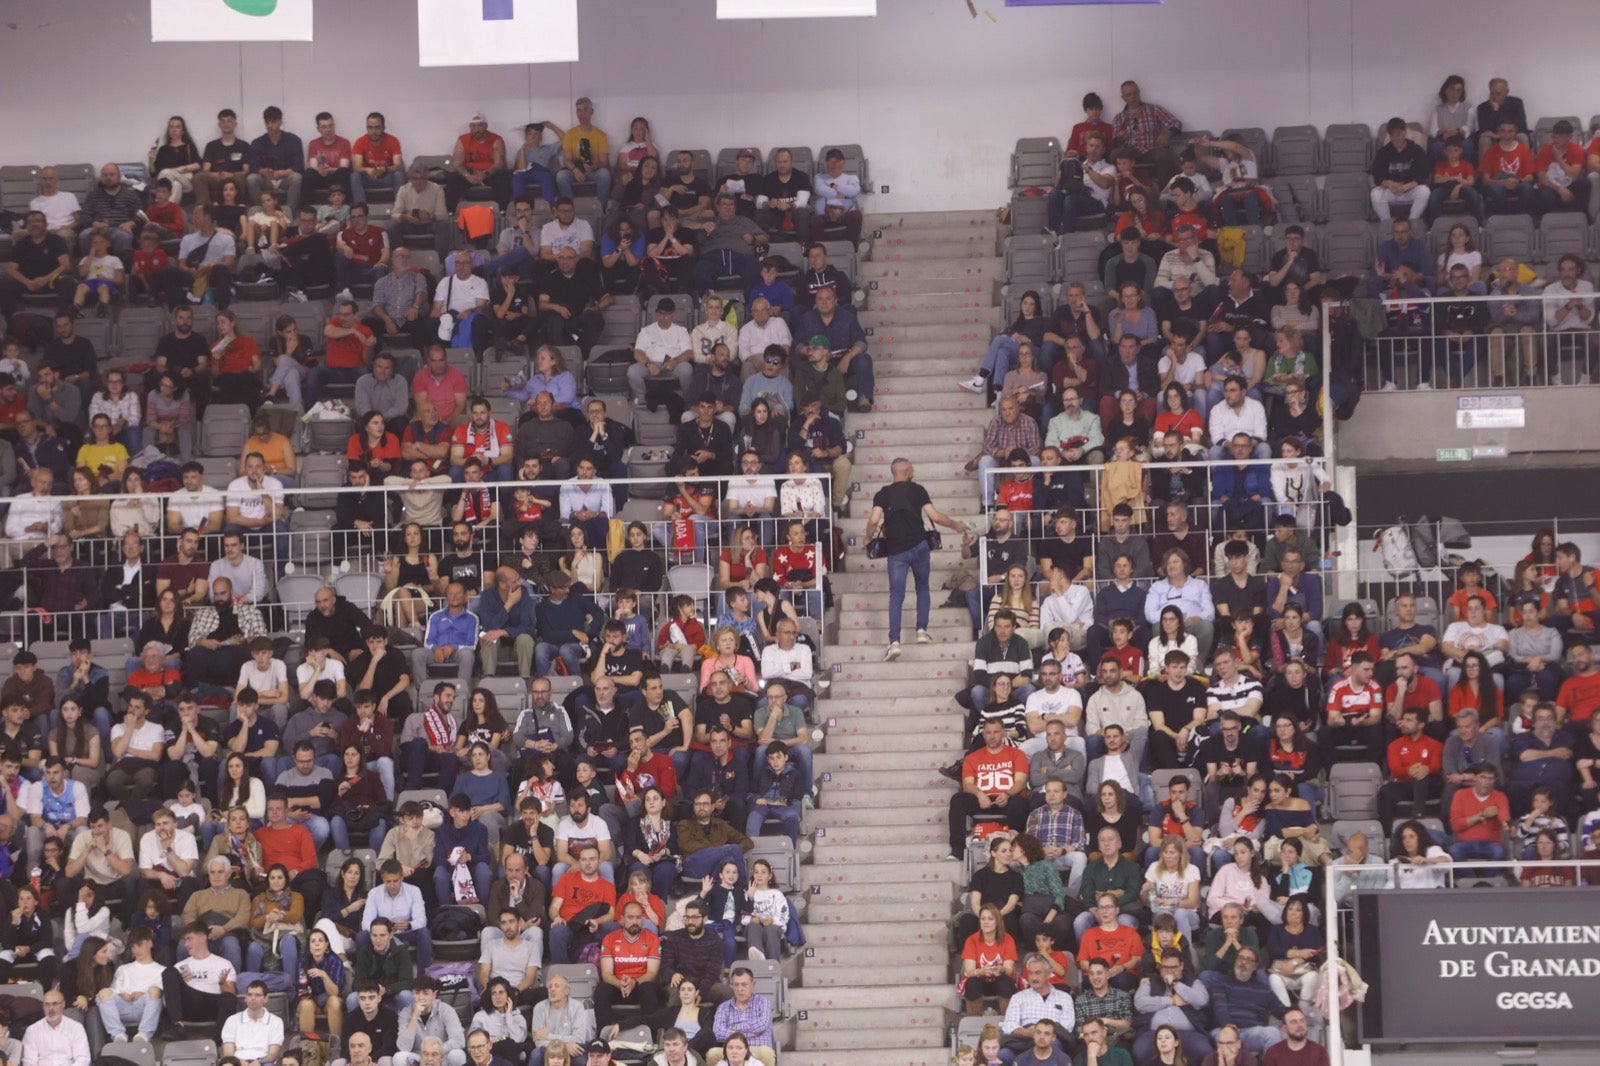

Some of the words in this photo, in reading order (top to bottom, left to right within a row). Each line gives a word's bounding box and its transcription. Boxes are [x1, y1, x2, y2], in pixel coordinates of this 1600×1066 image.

[1422, 919, 1600, 945] AYUNTAMIEN
[1439, 959, 1477, 978] DE
[1484, 951, 1600, 978] GRANAD
